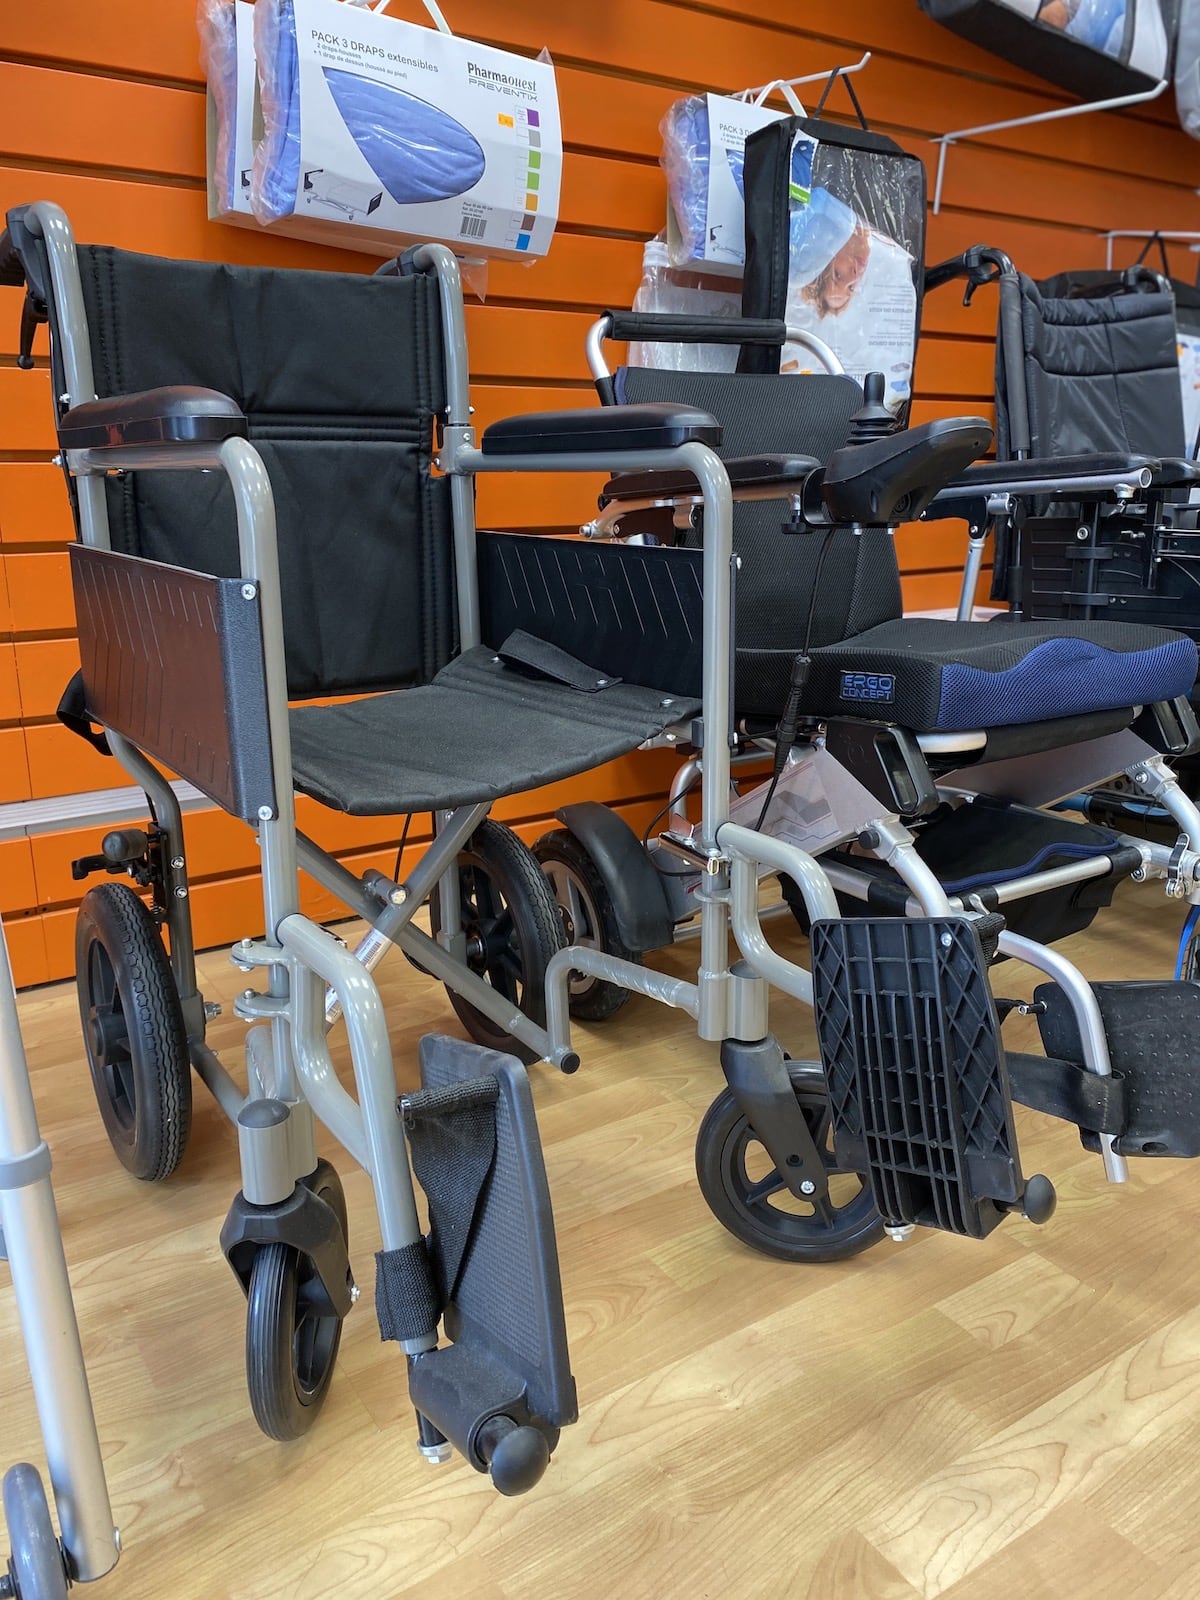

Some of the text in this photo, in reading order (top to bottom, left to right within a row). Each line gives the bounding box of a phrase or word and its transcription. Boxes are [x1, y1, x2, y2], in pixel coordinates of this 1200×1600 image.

[311, 29, 439, 73] PACK 3 DRAPS extensibles
[467, 61, 537, 92] Pharmaouest
[468, 77, 538, 102] PREVENTIX
[719, 123, 738, 135] PACK
[739, 127, 744, 136] 3
[844, 674, 893, 690] ERGO
[842, 687, 892, 700] CONCEPT
